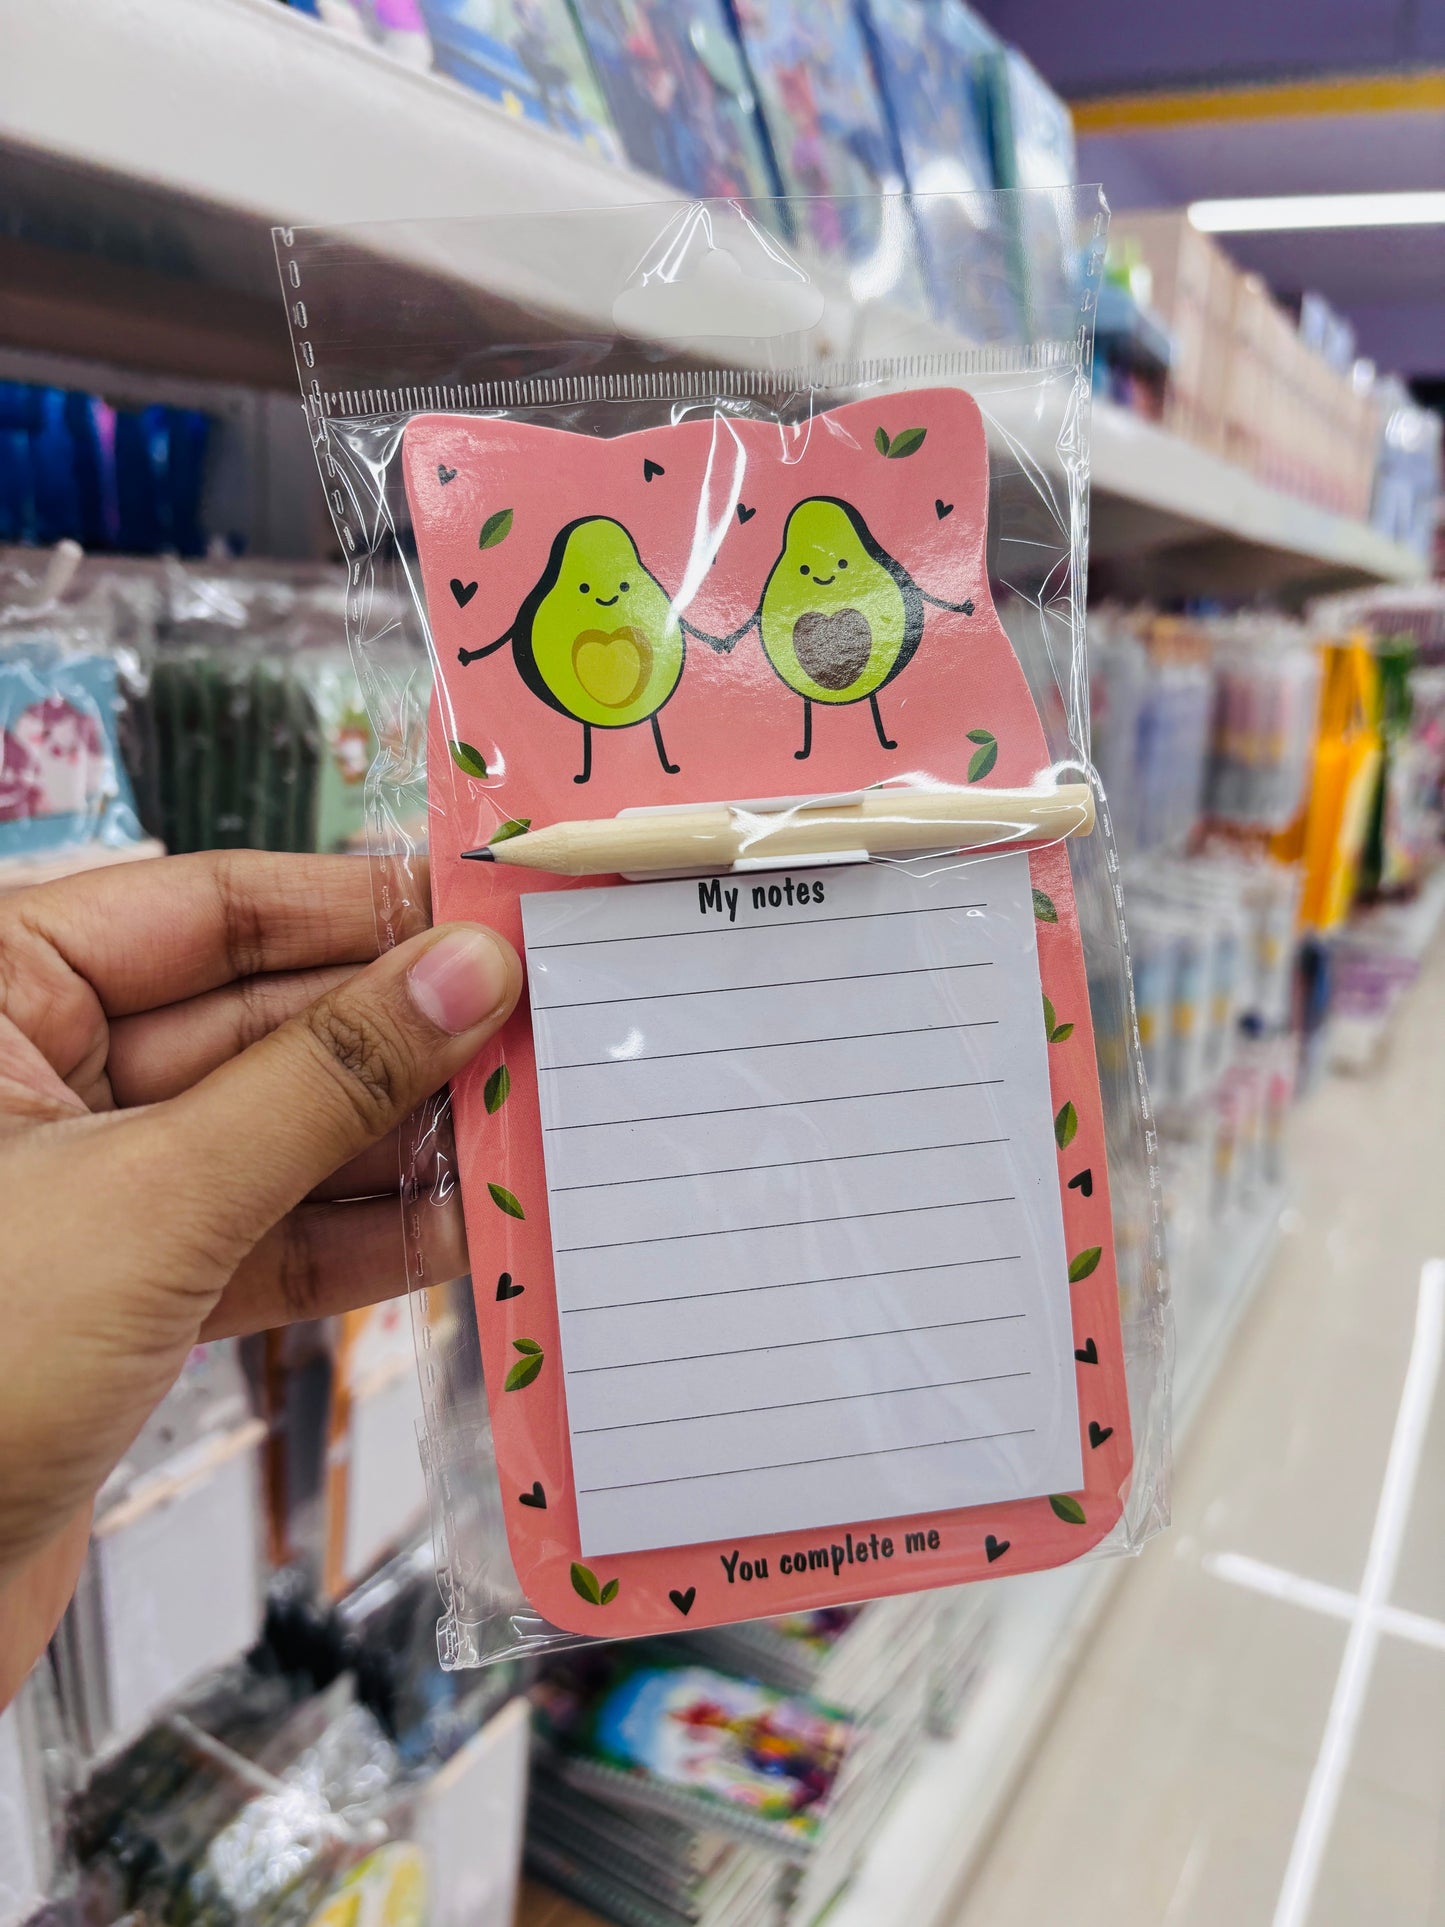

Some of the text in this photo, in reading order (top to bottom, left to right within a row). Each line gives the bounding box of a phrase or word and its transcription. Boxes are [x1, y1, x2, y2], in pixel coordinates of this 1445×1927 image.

[698, 877, 825, 922] My notes
[720, 1529, 941, 1584] You complete me
